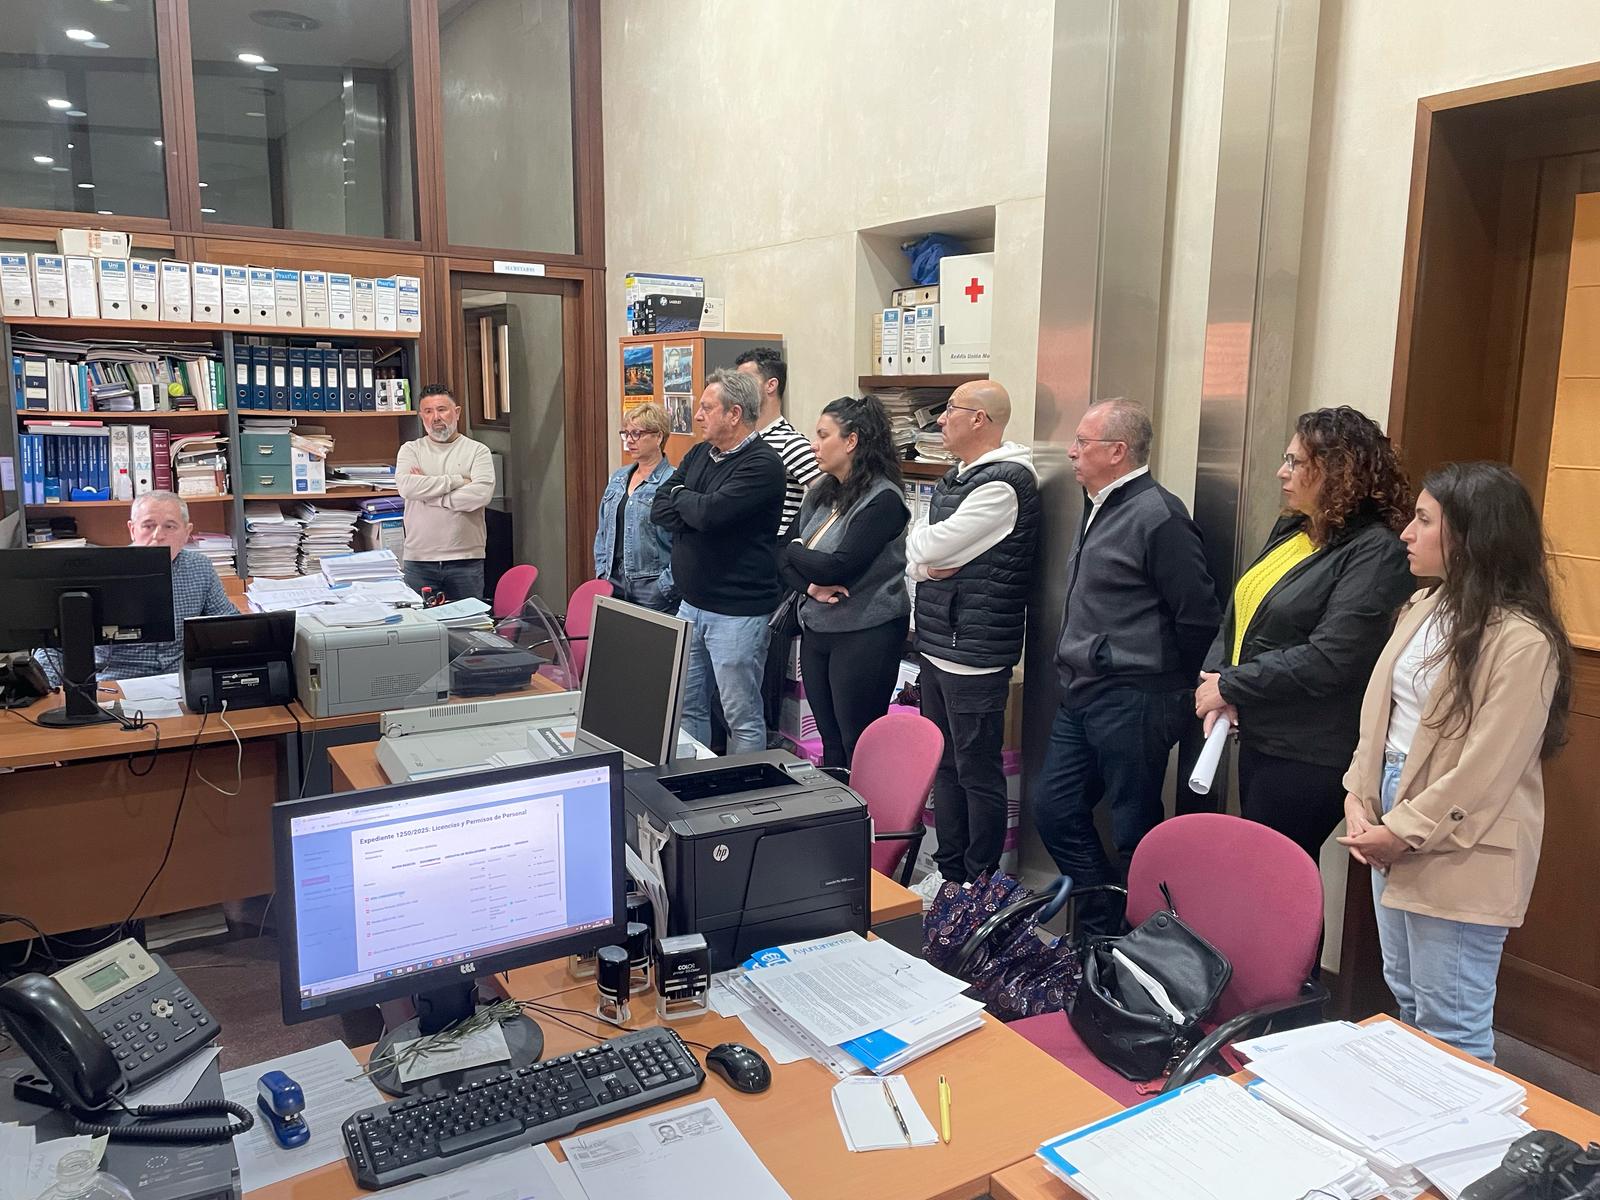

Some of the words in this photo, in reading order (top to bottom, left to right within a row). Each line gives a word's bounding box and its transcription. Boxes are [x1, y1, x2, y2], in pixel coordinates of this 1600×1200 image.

[360, 834, 395, 845] Expediente
[396, 827, 431, 838] 1250/2025:
[432, 822, 460, 832] Licencias
[466, 816, 493, 825] Permisos
[502, 809, 528, 819] Personal
[713, 844, 729, 861] hp
